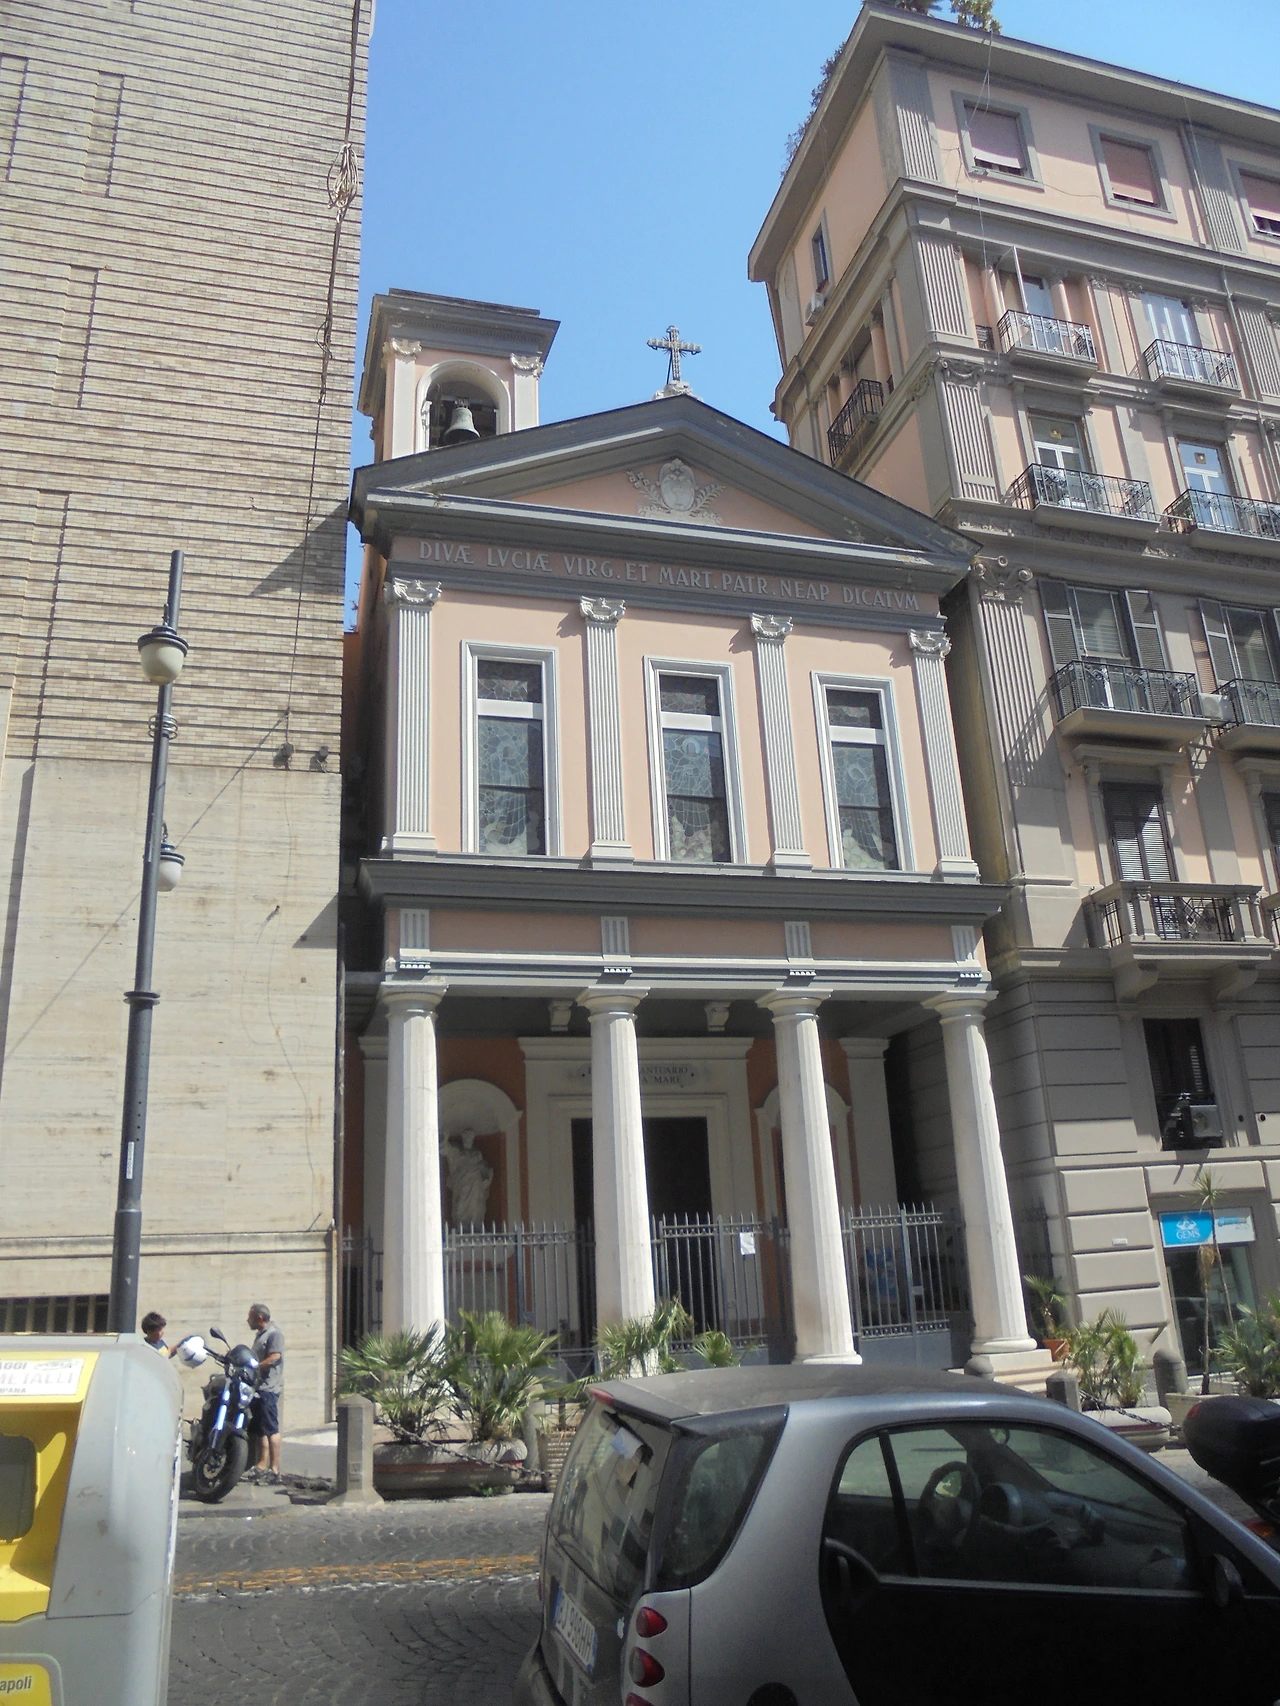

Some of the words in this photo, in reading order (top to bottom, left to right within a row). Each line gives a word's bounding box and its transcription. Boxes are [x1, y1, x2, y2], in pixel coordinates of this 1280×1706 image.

[419, 541, 474, 565] DIVÆ
[625, 562, 650, 583] ET
[780, 581, 830, 602] NEAP
[841, 587, 920, 612] DICATVM
[640, 1066, 688, 1075] ANTUARIO
[1176, 1230, 1201, 1240] GEMS
[0, 1361, 28, 1370] GGI
